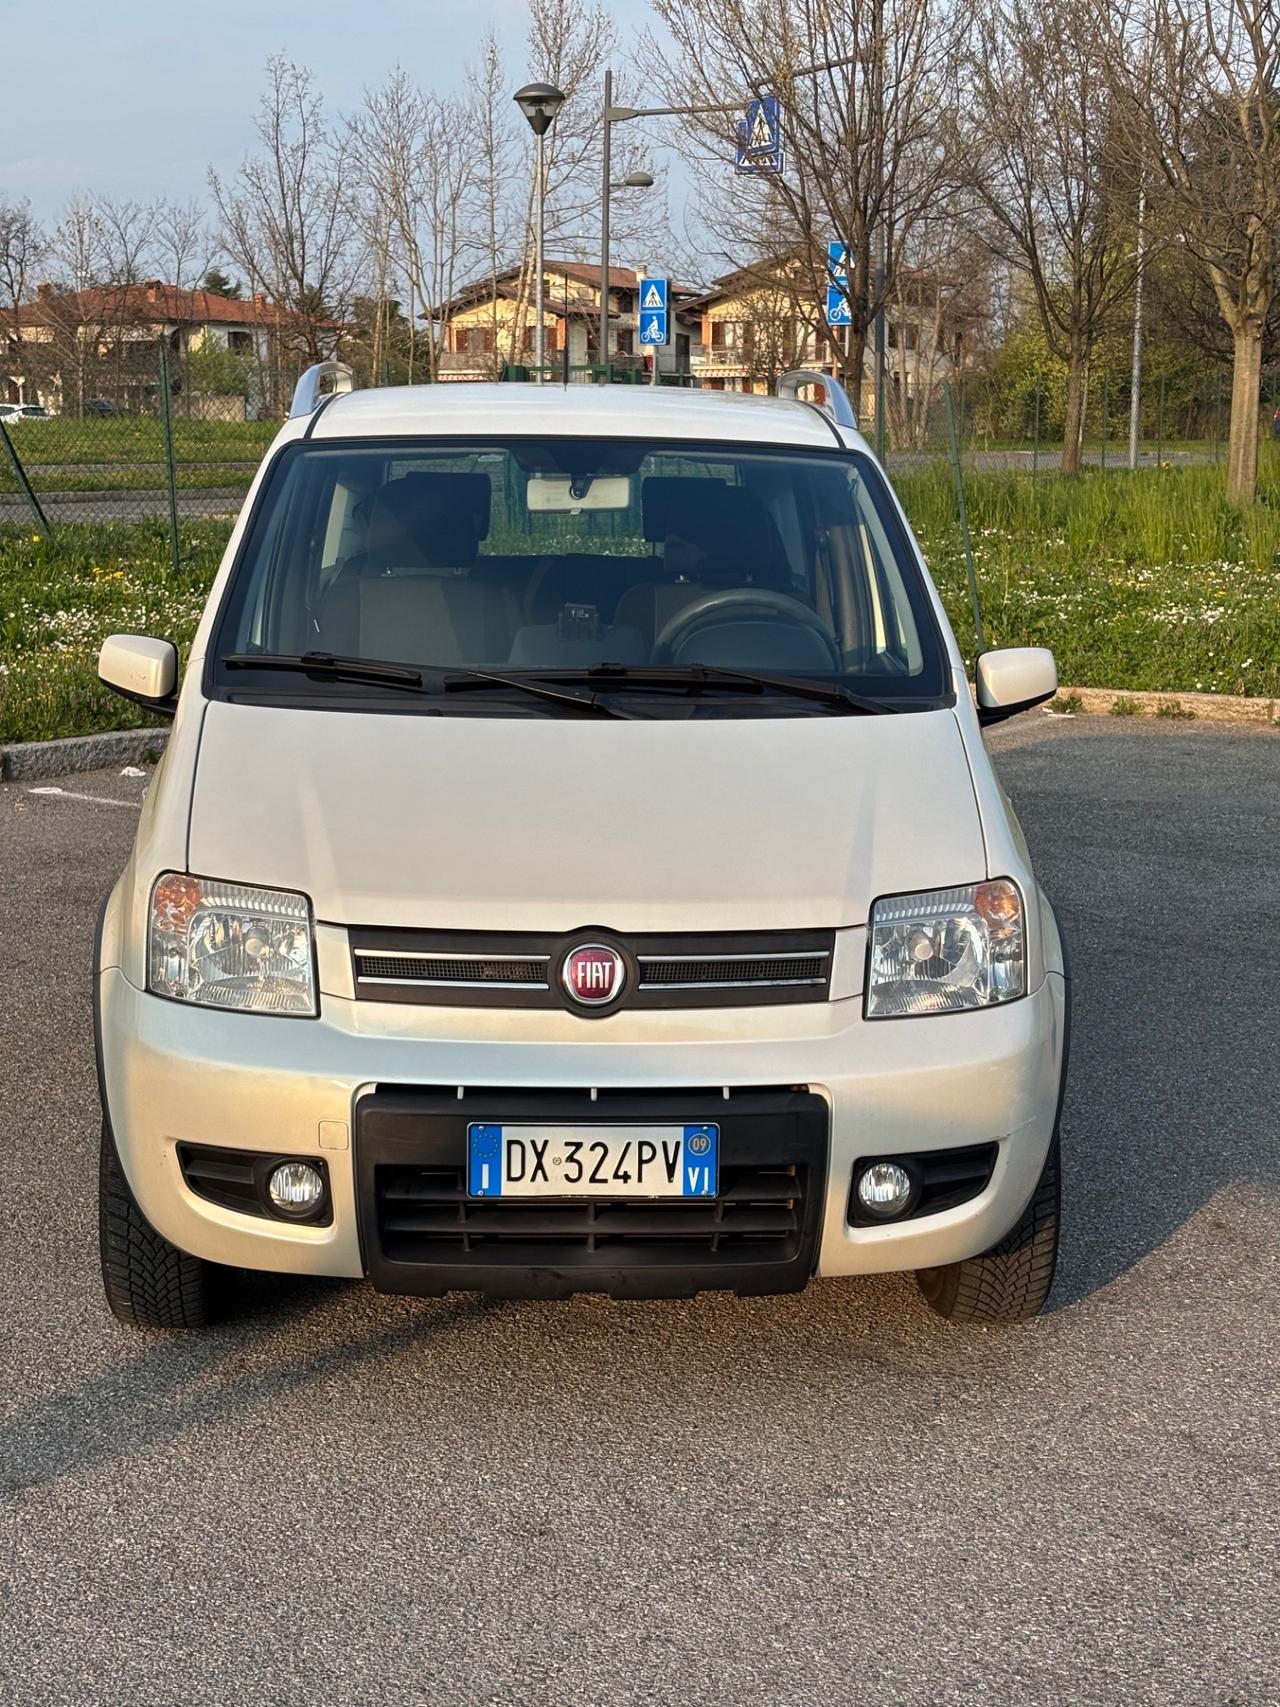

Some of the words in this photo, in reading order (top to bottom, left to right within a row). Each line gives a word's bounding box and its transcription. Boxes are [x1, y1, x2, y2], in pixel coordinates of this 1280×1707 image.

[577, 961, 613, 989] FIAT
[692, 1138, 707, 1150] 09
[481, 1163, 489, 1189] I
[687, 1166, 709, 1192] VI
